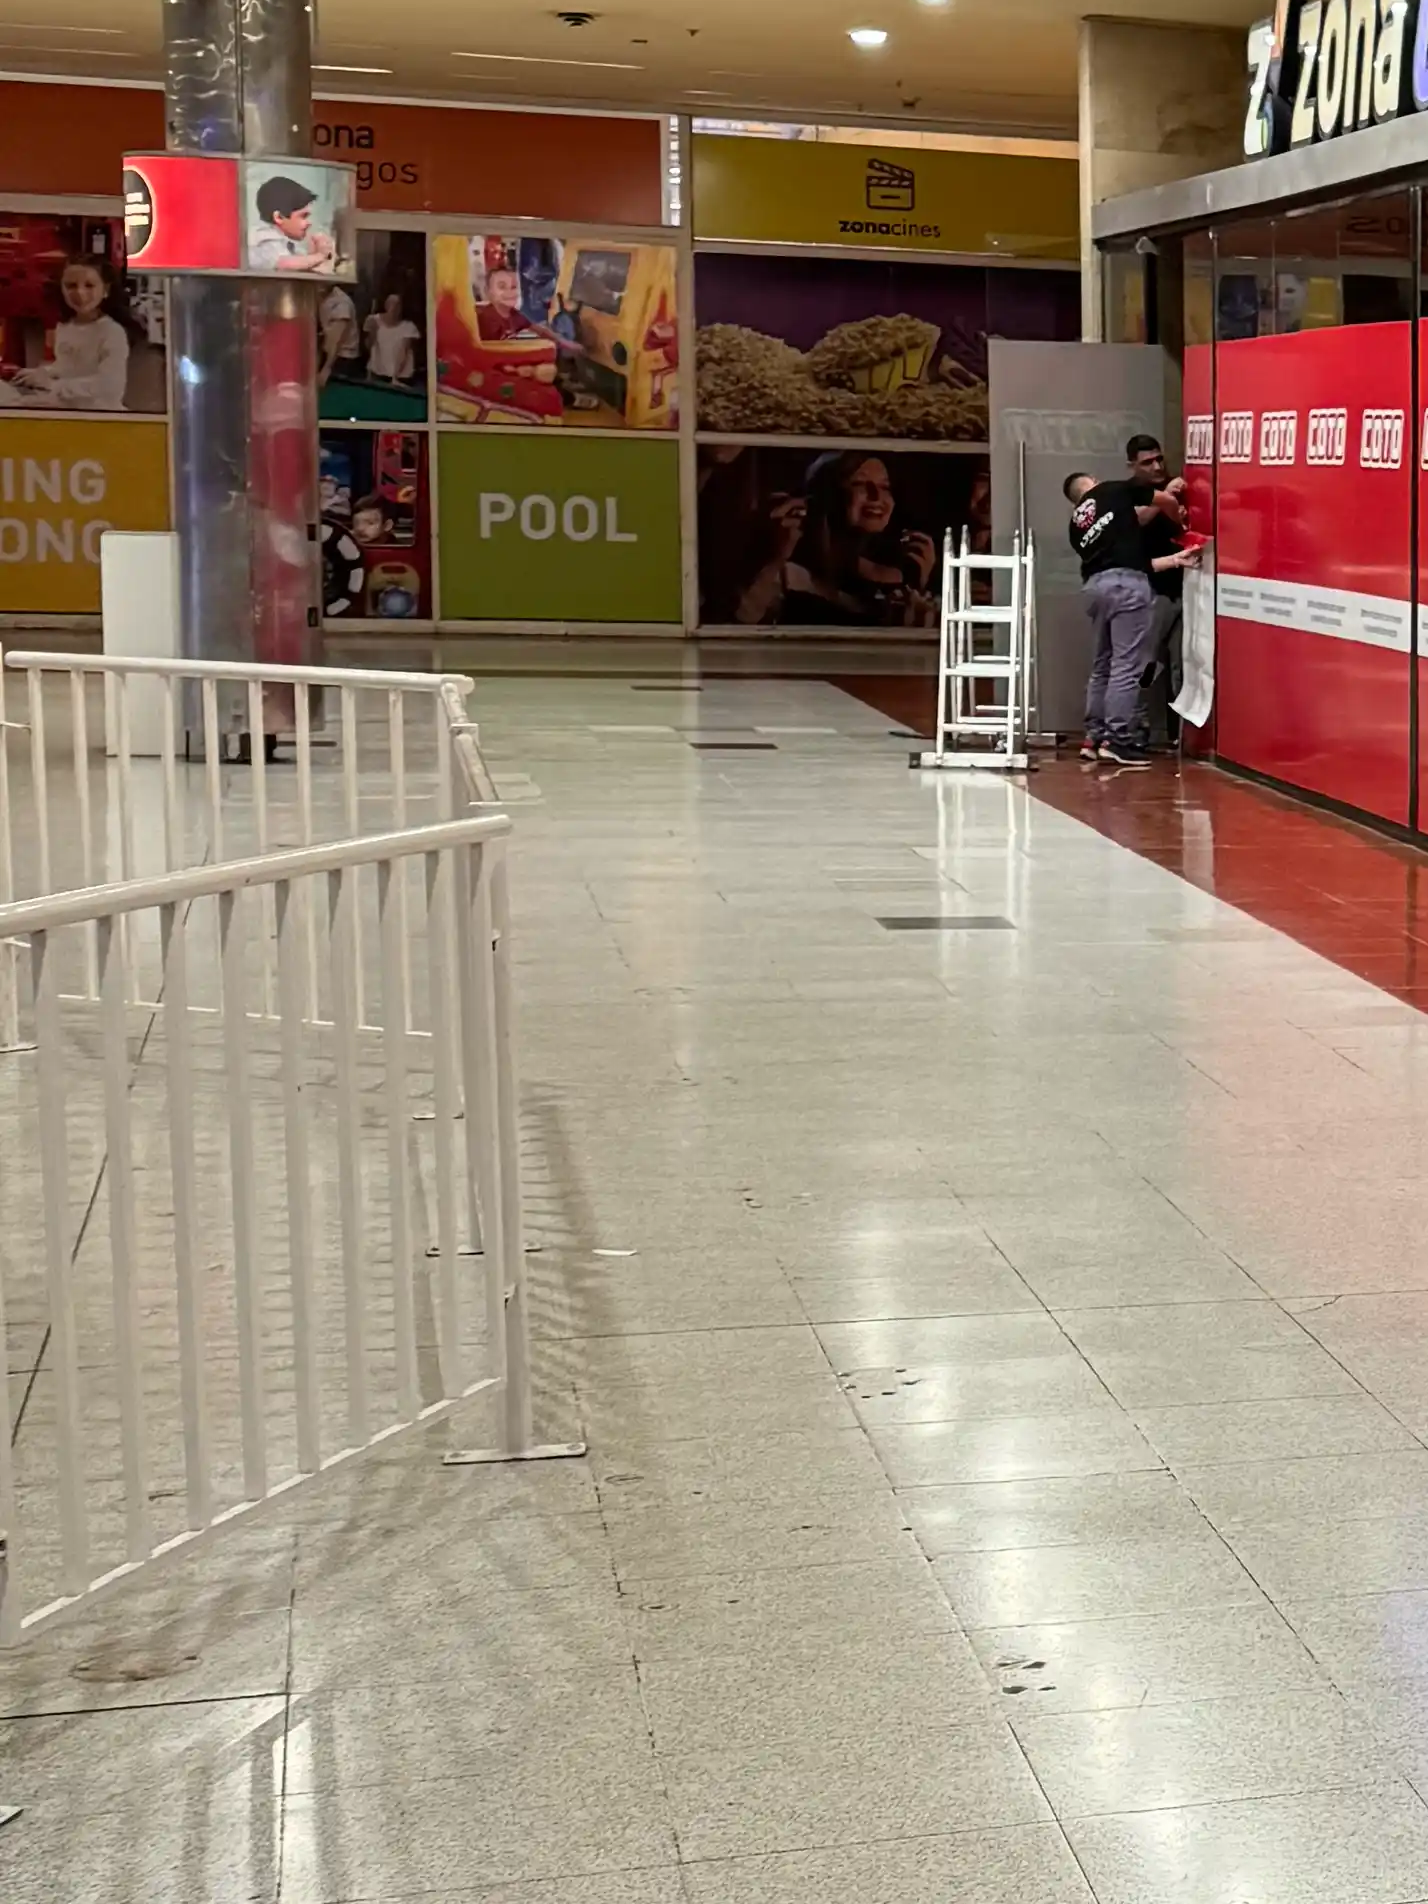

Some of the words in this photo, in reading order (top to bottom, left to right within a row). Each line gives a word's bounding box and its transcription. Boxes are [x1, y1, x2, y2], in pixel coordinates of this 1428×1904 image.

[313, 123, 374, 149] ona
[357, 161, 418, 191] gos
[839, 218, 940, 238] zonacines
[3, 458, 105, 504] ING
[480, 492, 638, 542] POOL
